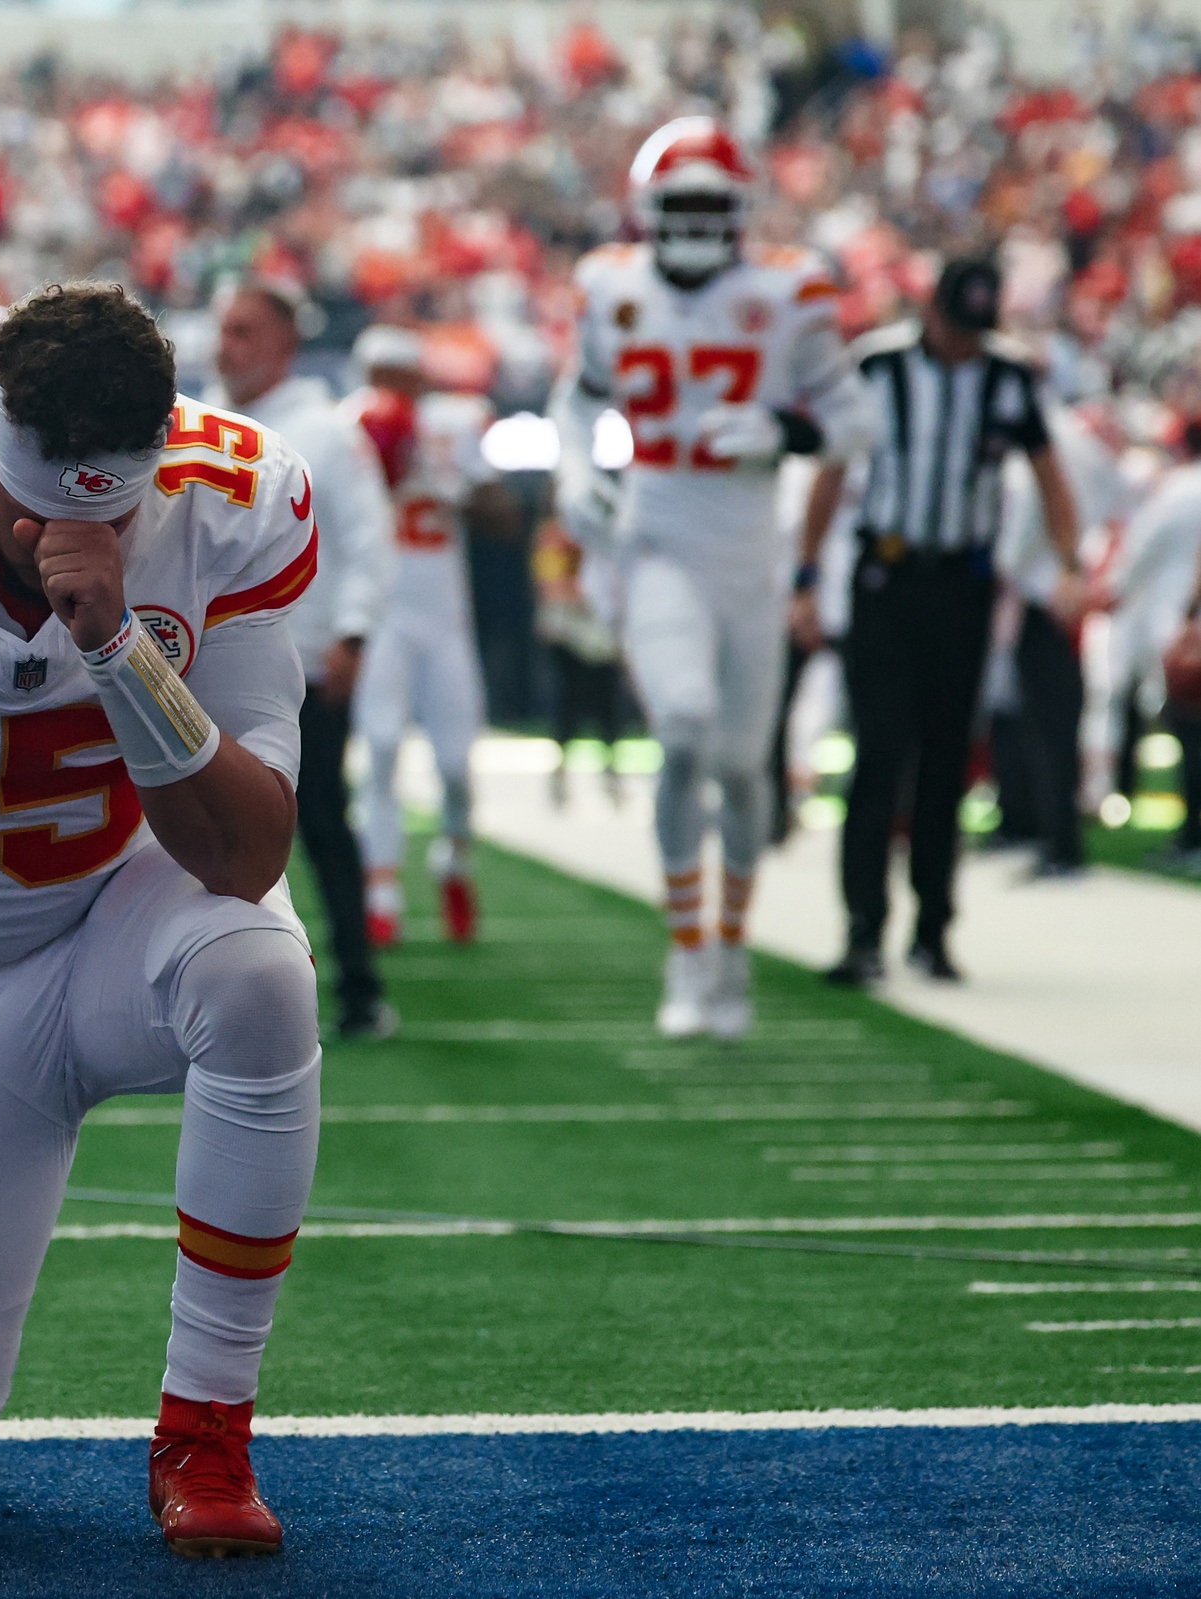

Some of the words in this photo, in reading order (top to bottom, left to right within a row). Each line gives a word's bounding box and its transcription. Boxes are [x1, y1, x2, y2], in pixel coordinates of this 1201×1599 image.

[616, 346, 762, 471] 27
[75, 471, 113, 492] KC
[153, 407, 263, 509] 15
[98, 641, 118, 657] THE
